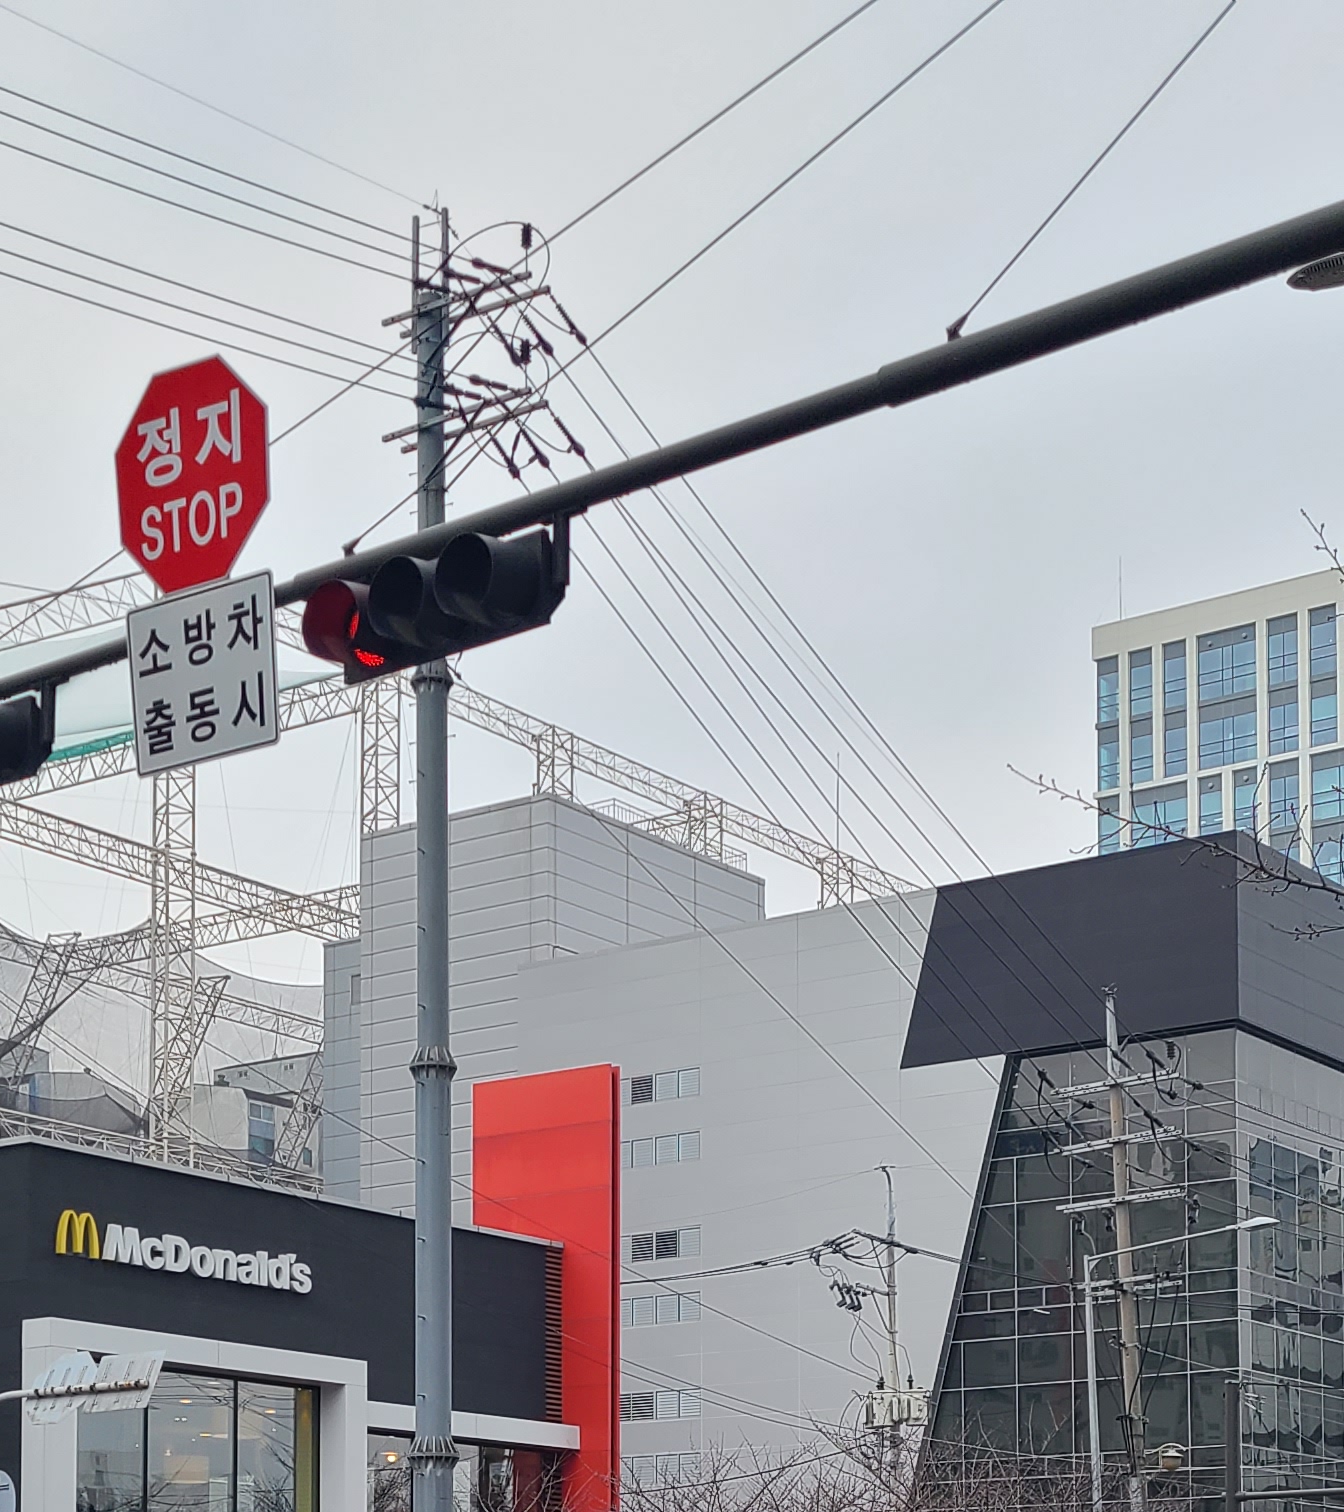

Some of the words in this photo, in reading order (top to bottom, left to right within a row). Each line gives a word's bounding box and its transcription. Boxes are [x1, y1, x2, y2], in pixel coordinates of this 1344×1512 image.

[136, 387, 243, 488] 정지
[140, 481, 243, 562] STOP
[137, 592, 265, 681] 소방차
[142, 669, 268, 756] 출동시
[102, 1223, 313, 1294] McDonald's
